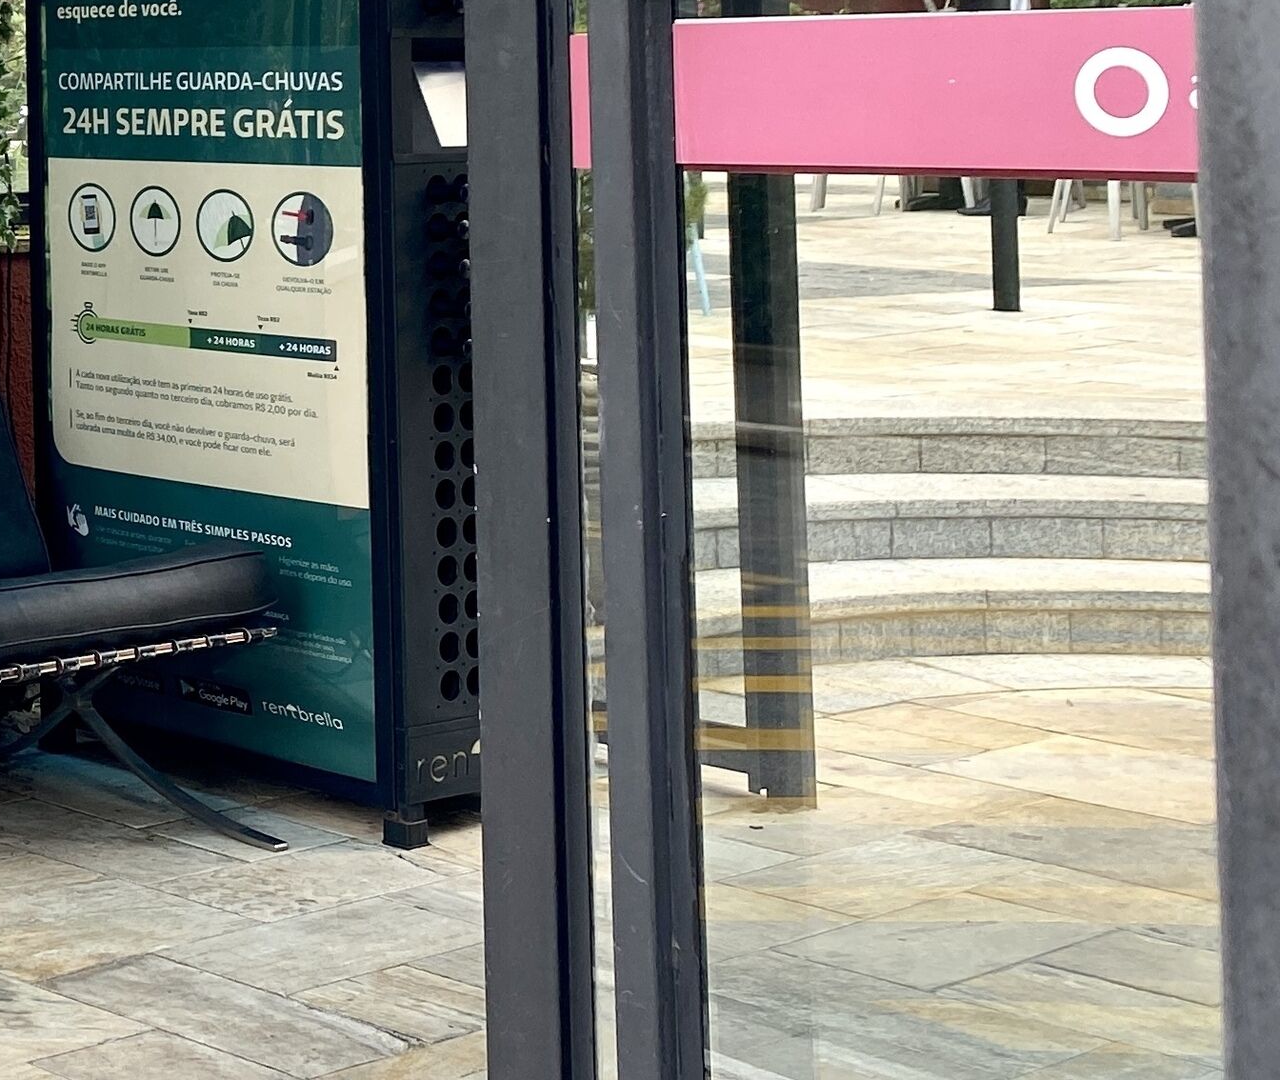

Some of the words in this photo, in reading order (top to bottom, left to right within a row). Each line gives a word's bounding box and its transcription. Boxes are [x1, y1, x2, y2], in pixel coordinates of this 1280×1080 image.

[57, 3, 115, 24] esquece
[118, 0, 137, 17] de
[59, 72, 172, 91] COMPARTILHE
[176, 71, 344, 92] GUARDA-CHUVAS
[62, 107, 109, 135] 24H
[116, 108, 226, 137] SEMPRE
[233, 98, 345, 140] GRÁTIS
[96, 324, 120, 335] HORAS
[214, 335, 225, 346] 24
[225, 336, 256, 349] HORAS
[287, 342, 299, 353] 24
[299, 344, 332, 356] HORAS
[142, 378, 157, 388] você
[171, 382, 180, 391] as
[180, 383, 212, 395] primeiras
[212, 385, 223, 395] 24
[223, 386, 244, 398] horas
[244, 389, 255, 399] de
[255, 392, 270, 401] uso
[160, 393, 170, 401] no
[171, 393, 199, 405] terceiro
[200, 396, 214, 408] dia,
[215, 399, 254, 411] cobramos
[255, 402, 266, 413] R$
[267, 405, 286, 416] 2,00
[287, 408, 301, 418] por
[303, 408, 319, 419] dia.
[107, 414, 116, 423] do
[142, 419, 154, 430] dia,
[154, 422, 171, 431] você
[171, 424, 185, 433] não
[185, 424, 217, 437] devolver
[224, 430, 278, 447] guarda-chuva,
[279, 437, 296, 448] será
[136, 430, 145, 440] de
[146, 432, 156, 441] R$
[156, 433, 179, 446] 34,00,
[179, 437, 184, 445] e
[185, 438, 202, 448] você
[203, 439, 221, 450] pode
[223, 441, 239, 452] ficar
[240, 445, 257, 454] com
[258, 446, 273, 457] ele.
[94, 505, 117, 519] MAIS
[118, 510, 160, 527] CUIDADO
[162, 517, 178, 529] EM
[179, 519, 203, 534] TRÊS
[204, 524, 250, 541] SIMPLES
[251, 531, 293, 548] PASSOS
[198, 688, 230, 707] Google
[229, 695, 249, 712] Play
